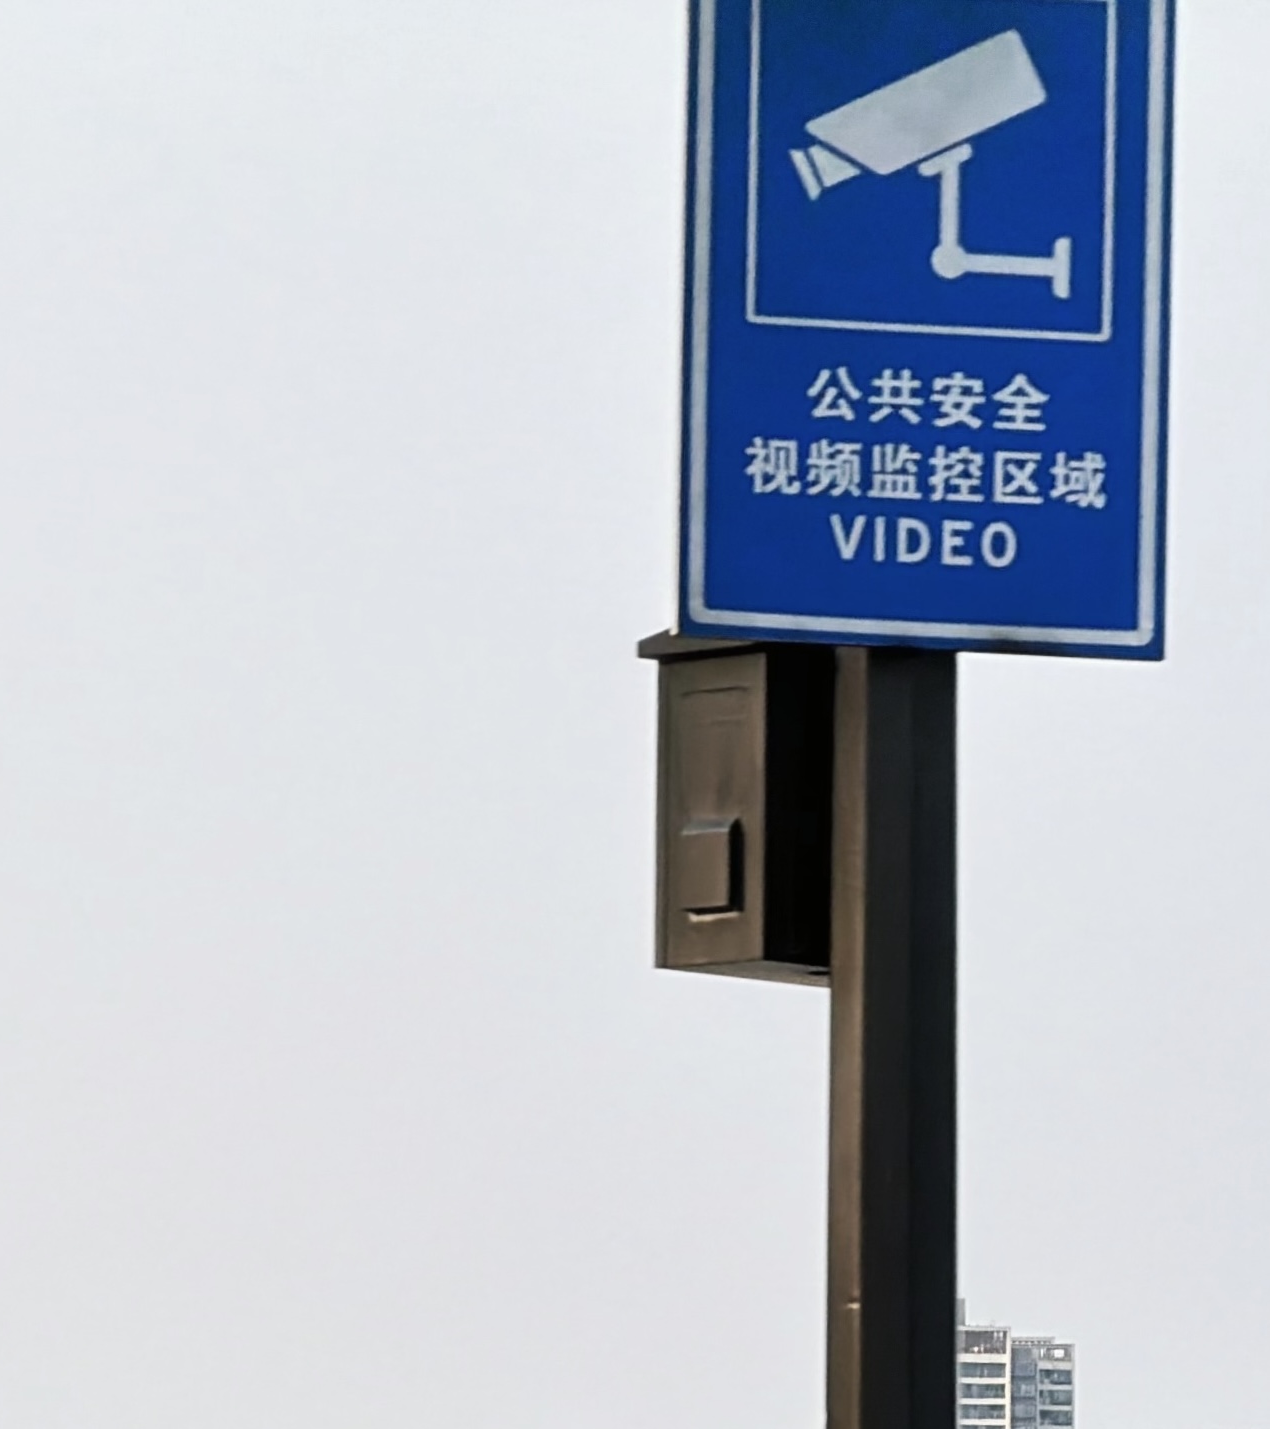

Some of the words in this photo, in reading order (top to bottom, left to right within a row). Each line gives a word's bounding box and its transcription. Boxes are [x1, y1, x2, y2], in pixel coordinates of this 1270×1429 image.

[806, 365, 1051, 433] 公共安全
[744, 436, 1109, 510] 视频监控区域
[829, 513, 1019, 569] VIDEO
